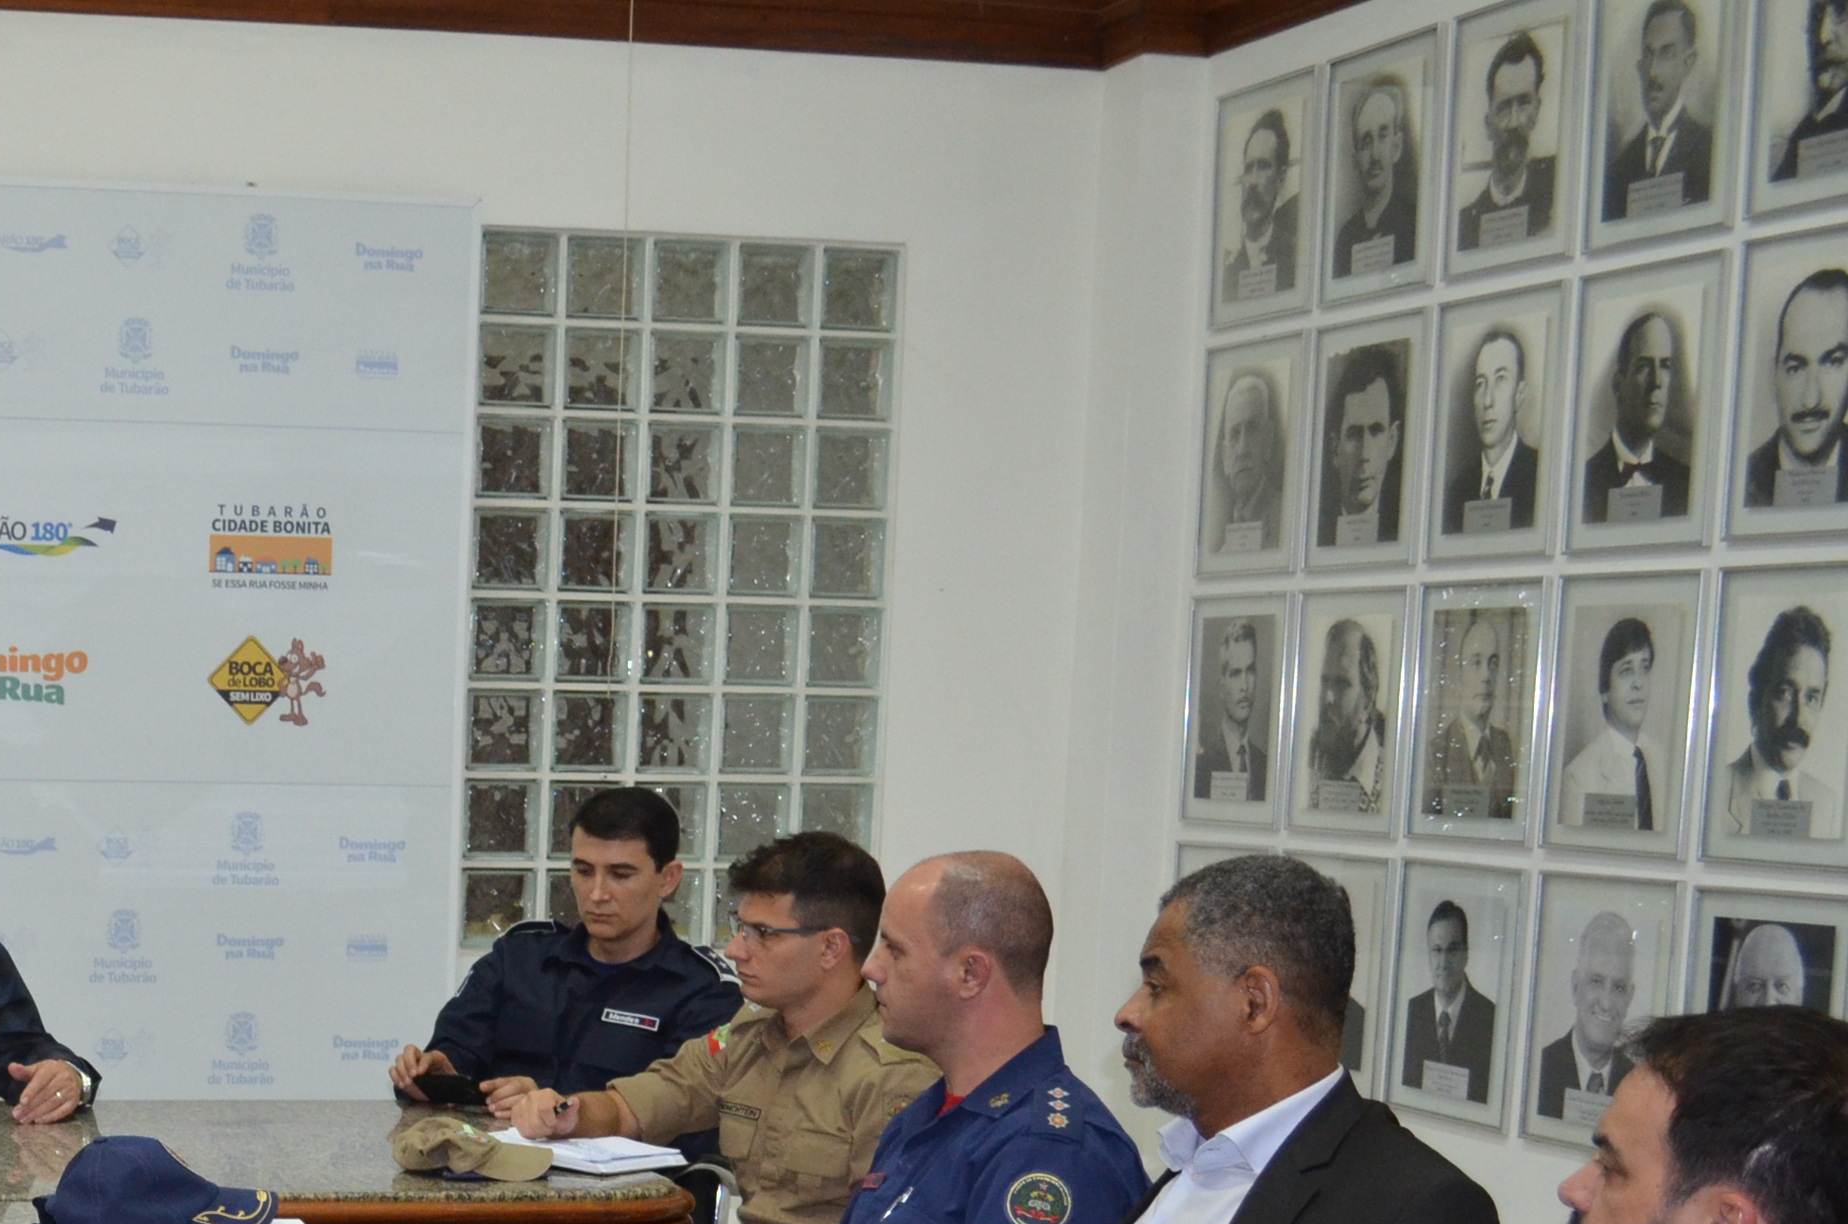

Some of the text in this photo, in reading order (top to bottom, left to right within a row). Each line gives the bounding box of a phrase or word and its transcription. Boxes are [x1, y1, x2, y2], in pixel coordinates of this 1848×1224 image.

[218, 504, 326, 519] TUBARÃO
[212, 519, 330, 534] CIDADE BONITA
[212, 578, 328, 590] SE ESSA RUA FOSSE MINHA
[228, 660, 274, 676] BOCA
[226, 676, 275, 688] de LOBO
[228, 691, 272, 704] SEM LIXO
